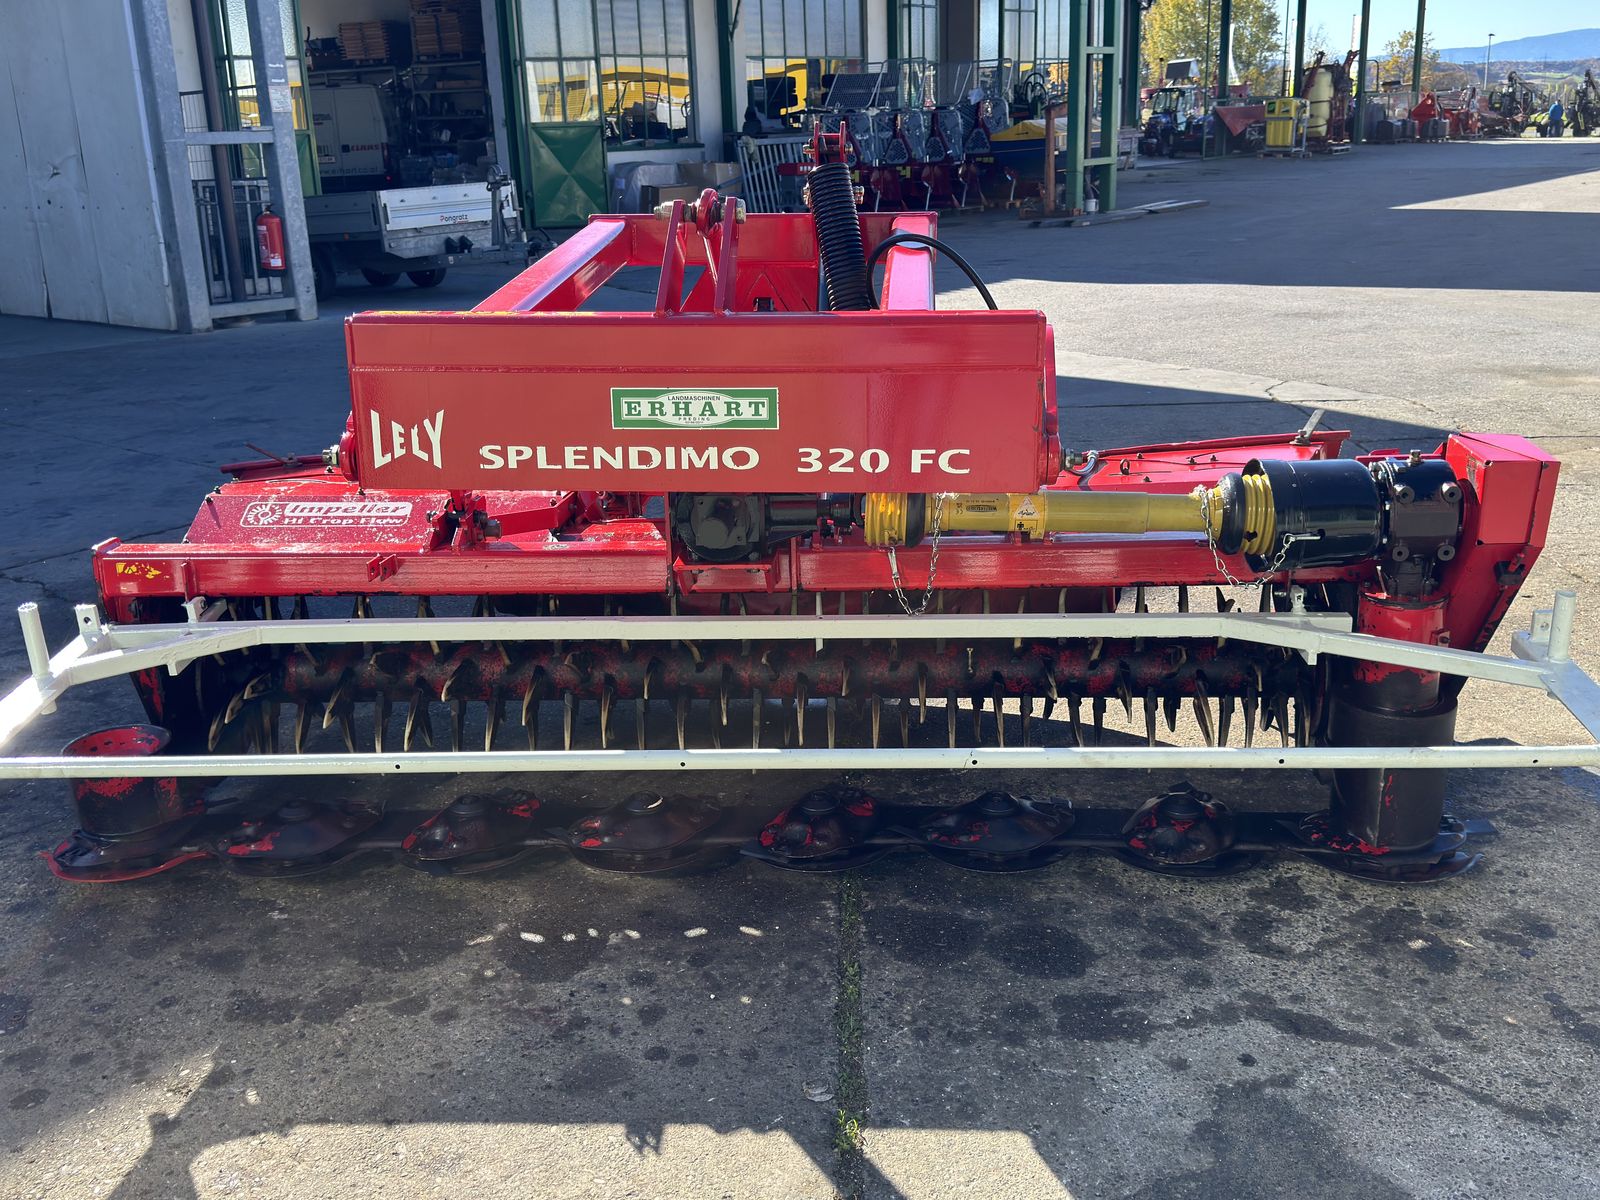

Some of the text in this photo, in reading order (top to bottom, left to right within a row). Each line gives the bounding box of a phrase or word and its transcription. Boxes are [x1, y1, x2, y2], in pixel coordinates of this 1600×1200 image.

[440, 214, 468, 223] Pongratz
[624, 401, 766, 417] ERHART
[370, 409, 445, 469] LELY
[479, 446, 971, 474] SPLENDIMO 320 FC
[289, 504, 407, 515] Impeller
[309, 517, 354, 526] Crop
[360, 516, 403, 525] Flow
